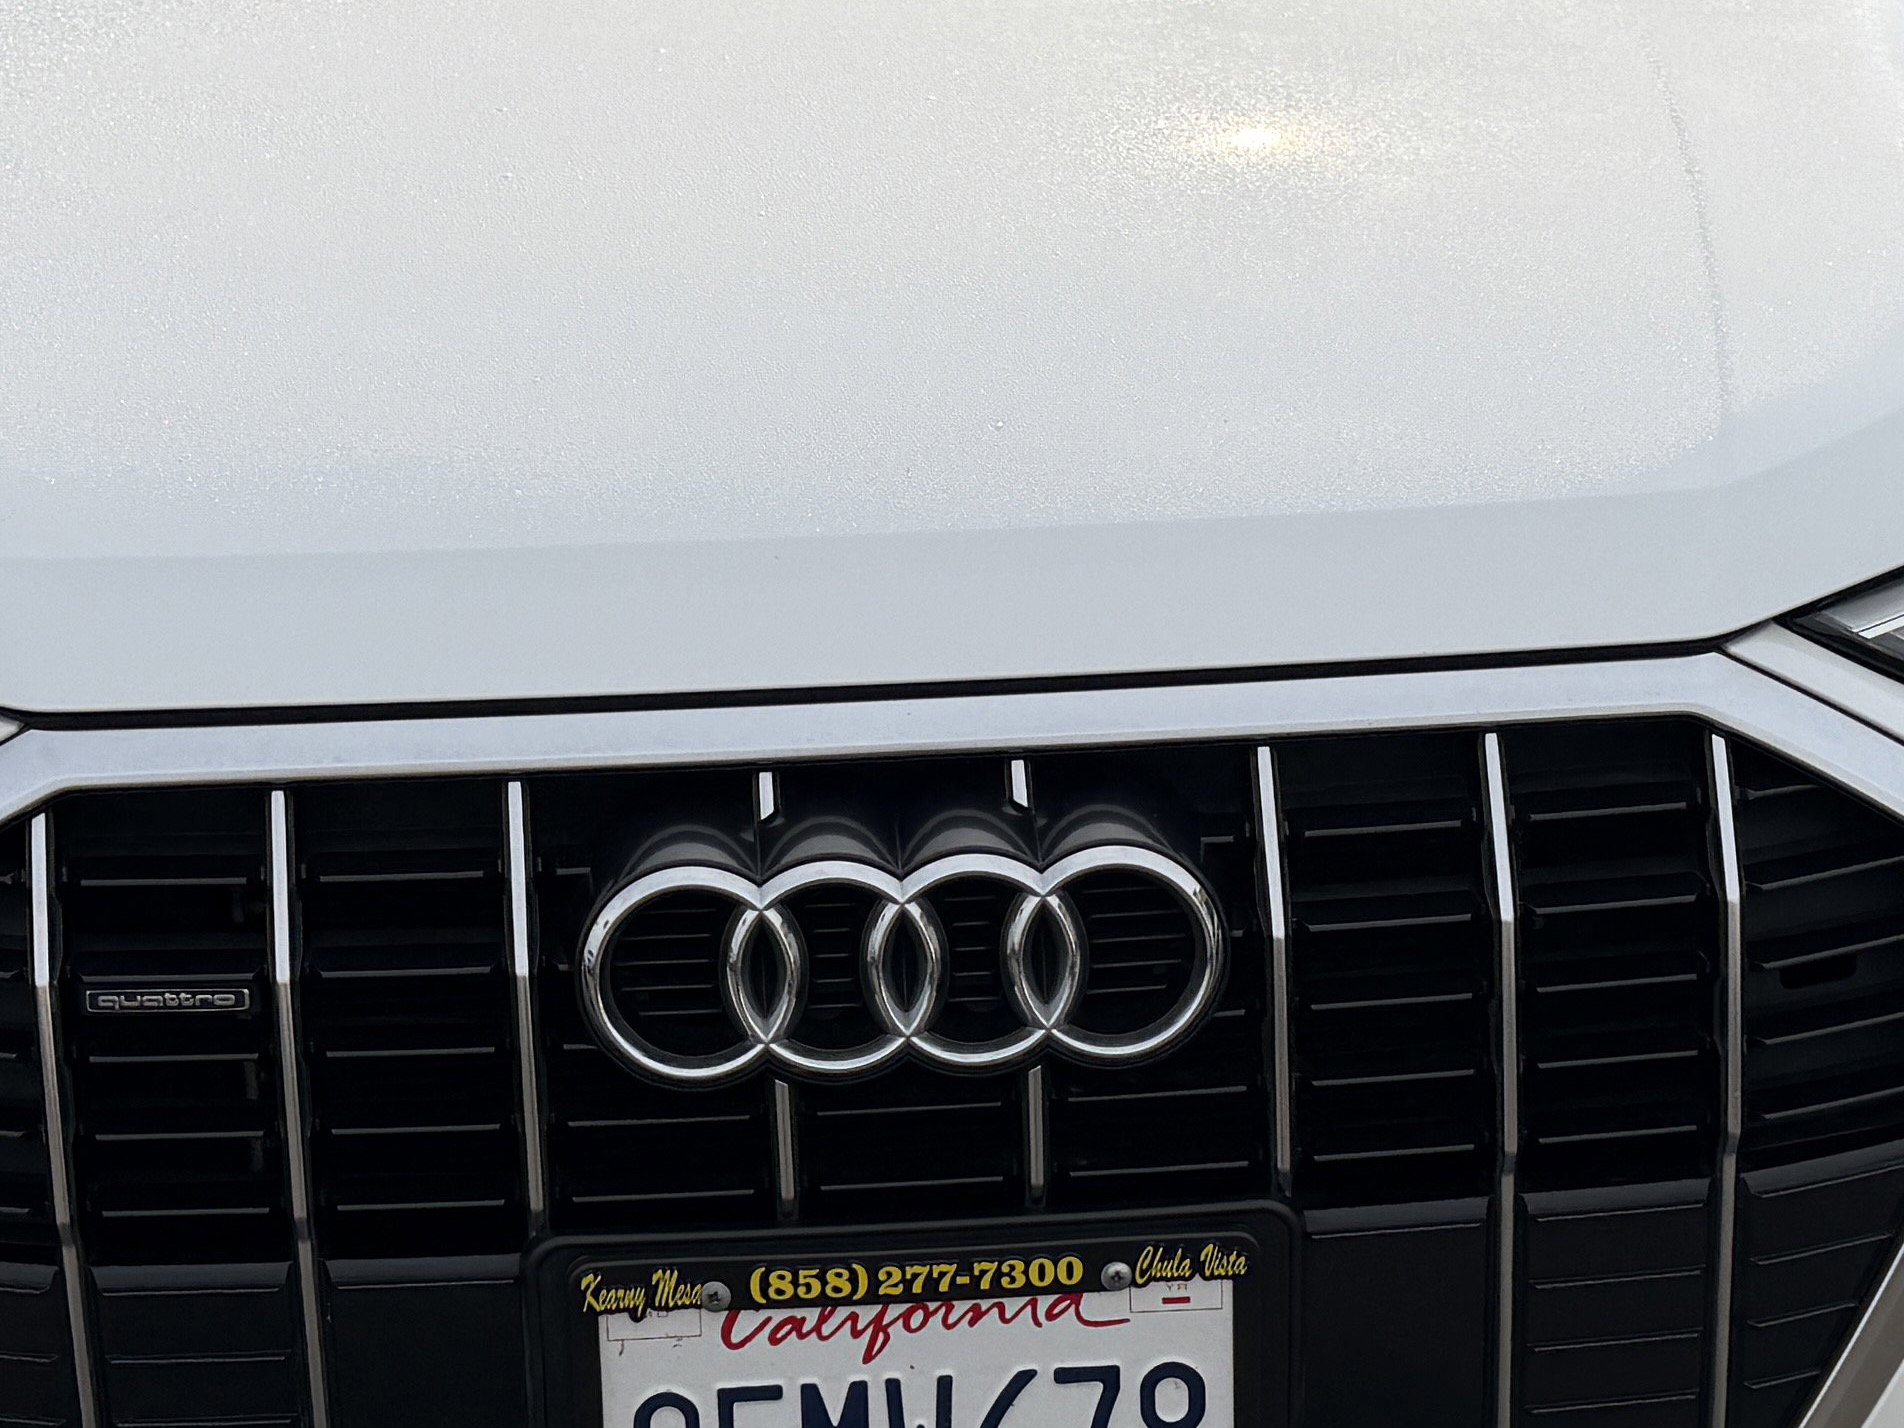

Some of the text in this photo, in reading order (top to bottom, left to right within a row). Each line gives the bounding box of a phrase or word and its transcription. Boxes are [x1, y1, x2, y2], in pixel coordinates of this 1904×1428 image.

[97, 992, 236, 1010] quattro
[749, 1255, 1084, 1304] (858) 277-7300
[1135, 1242, 1249, 1285] Chula Vista
[581, 1273, 645, 1318] Kearny
